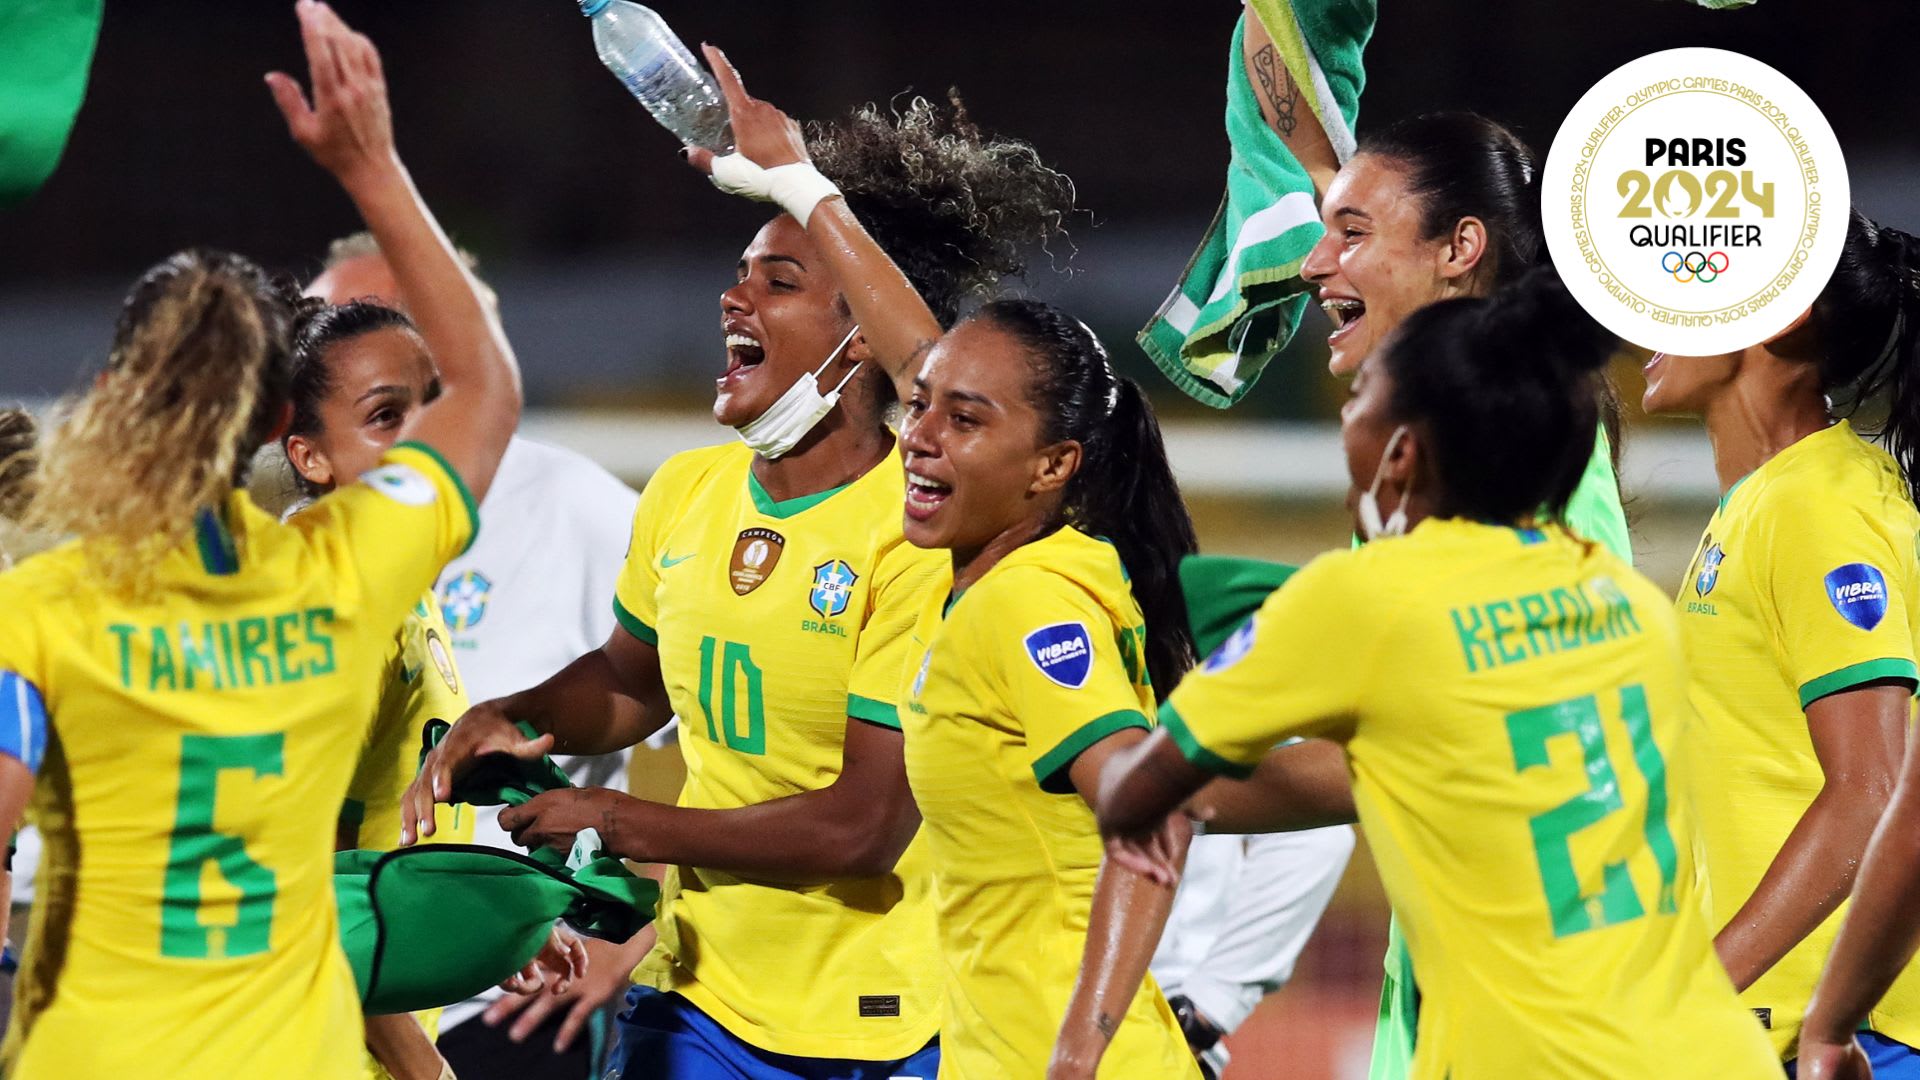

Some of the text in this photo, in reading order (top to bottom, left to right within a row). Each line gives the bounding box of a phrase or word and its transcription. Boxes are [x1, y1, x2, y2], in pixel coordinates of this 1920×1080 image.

[823, 582, 840, 591] CBF
[1836, 582, 1882, 599] VIBRA
[1687, 602, 1718, 616] BRASIL
[802, 620, 847, 637] BRASIL
[107, 607, 336, 691] TAMIRES
[1037, 636, 1084, 661] VIBRA
[698, 636, 766, 755] 10
[1504, 683, 1679, 940] 21
[160, 732, 286, 959] 6
